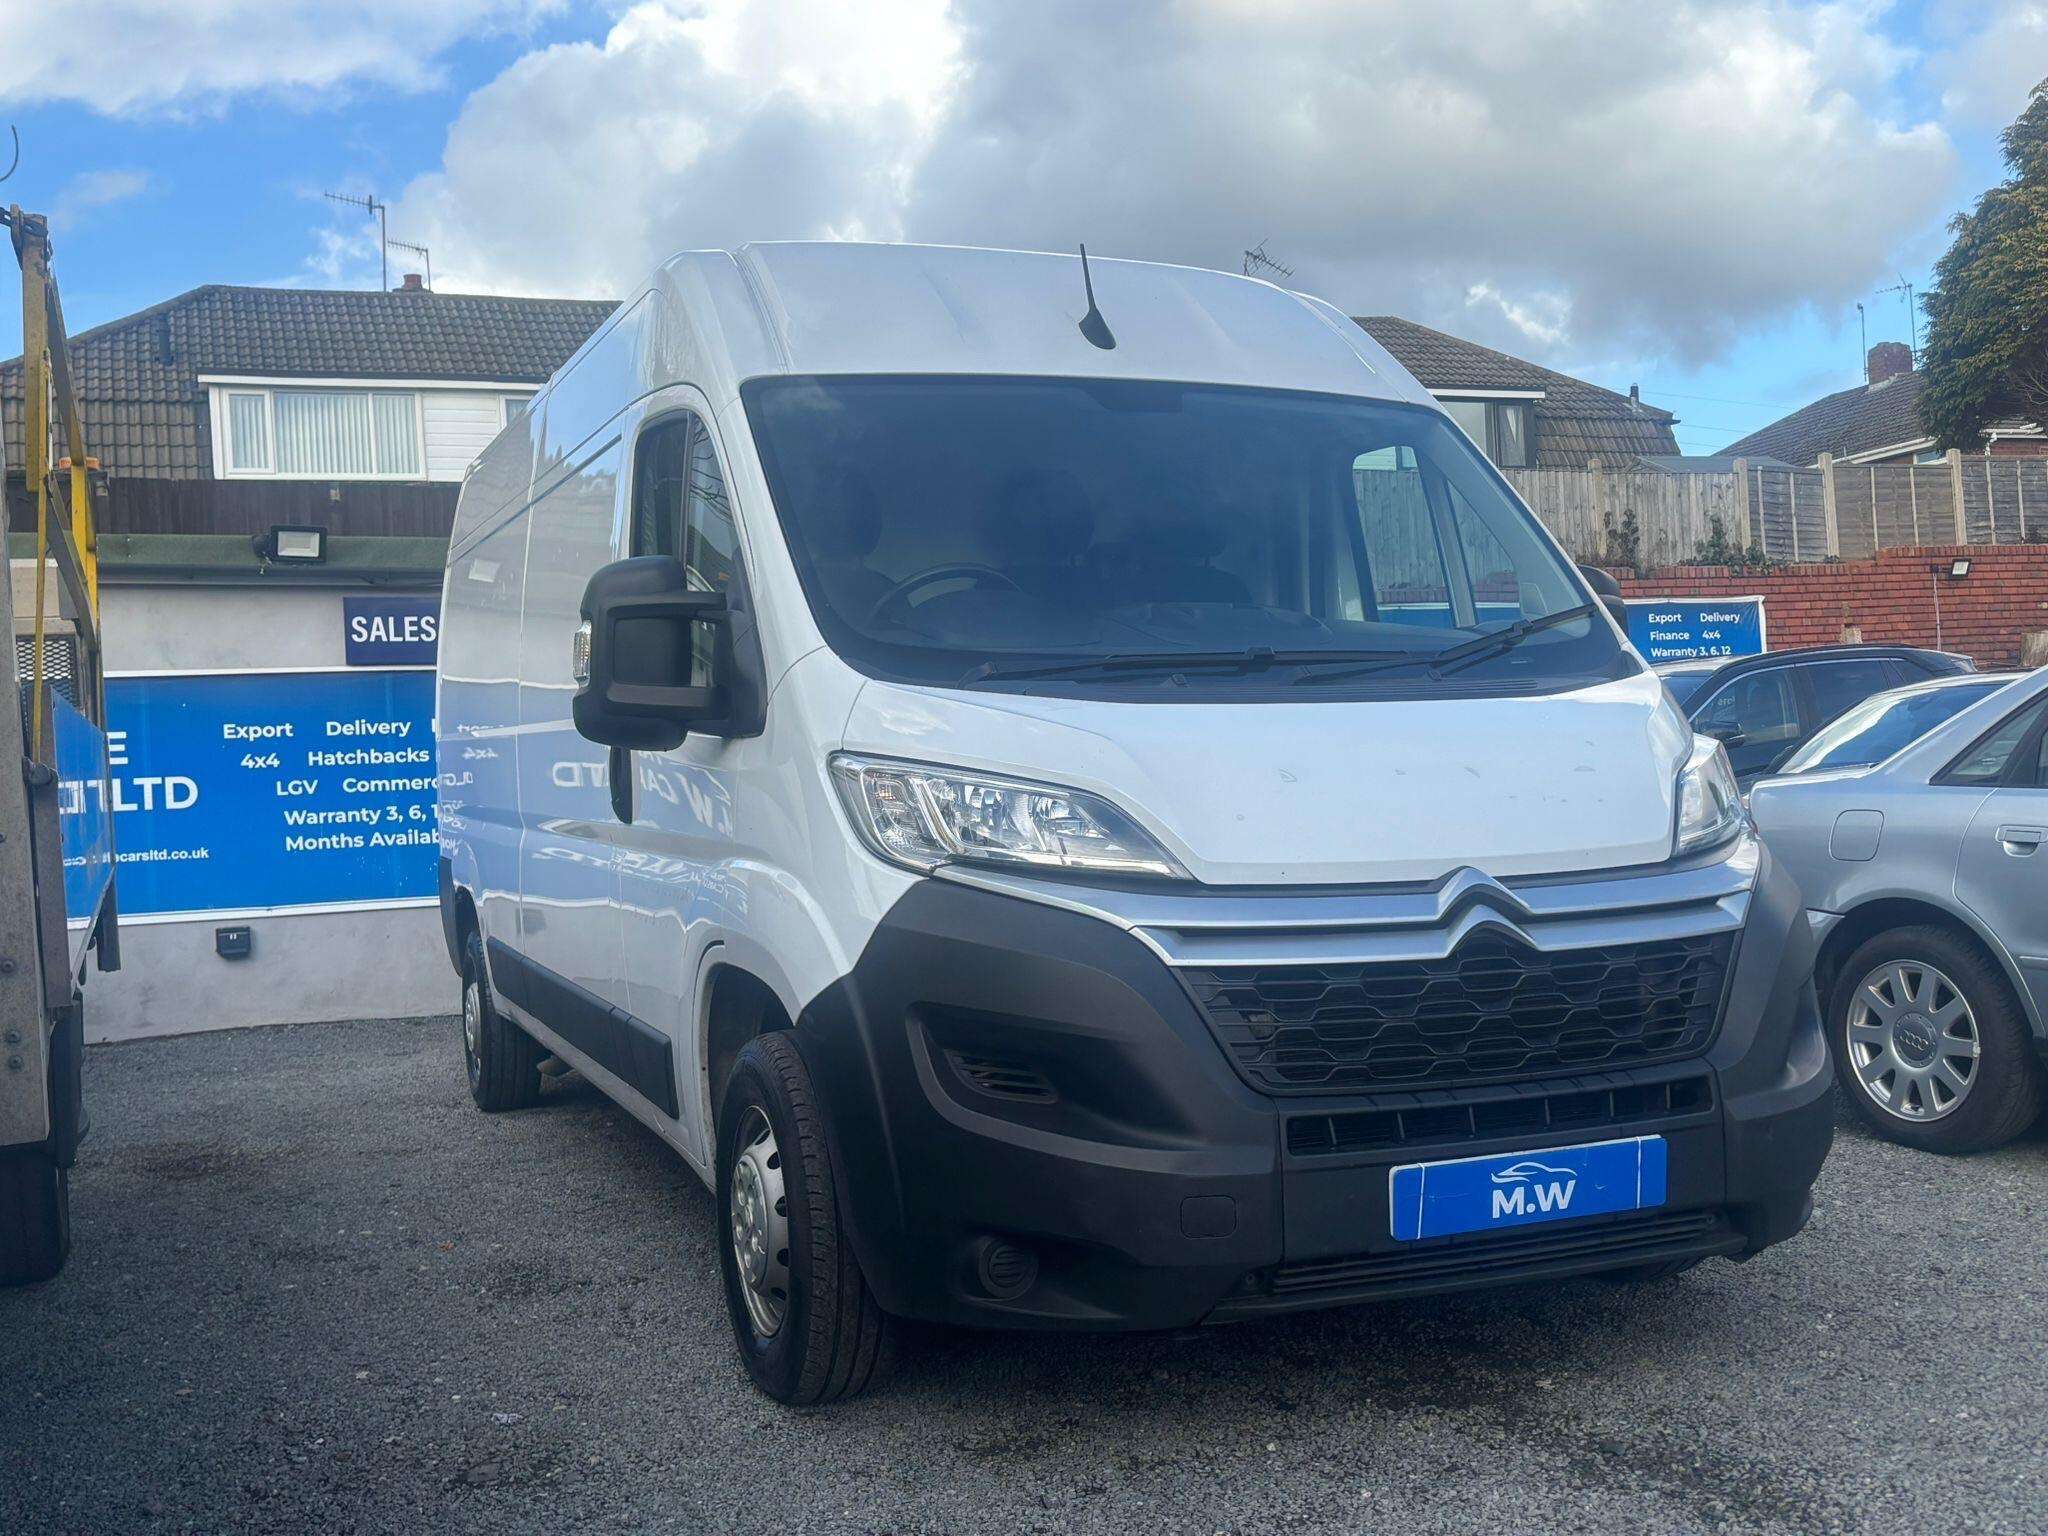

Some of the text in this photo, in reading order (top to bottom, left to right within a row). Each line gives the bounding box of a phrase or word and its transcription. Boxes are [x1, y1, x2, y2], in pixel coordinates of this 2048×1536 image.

[1649, 612, 1740, 624] Export Delivery
[351, 616, 437, 642] SALES
[1650, 630, 1721, 641] Finance 4x4
[1652, 648, 1697, 657] Warranty
[1721, 646, 1731, 656] 12
[223, 723, 294, 741] Export
[326, 719, 411, 738] Delivery
[240, 748, 430, 769] 4x4 Hatchbacks
[112, 776, 199, 812] LTD
[276, 780, 318, 796] LGV
[284, 806, 381, 826] Warranty
[386, 805, 403, 823] 3,
[409, 804, 426, 822] 6,
[285, 832, 364, 851] Months
[1492, 1179, 1576, 1219] M.W
